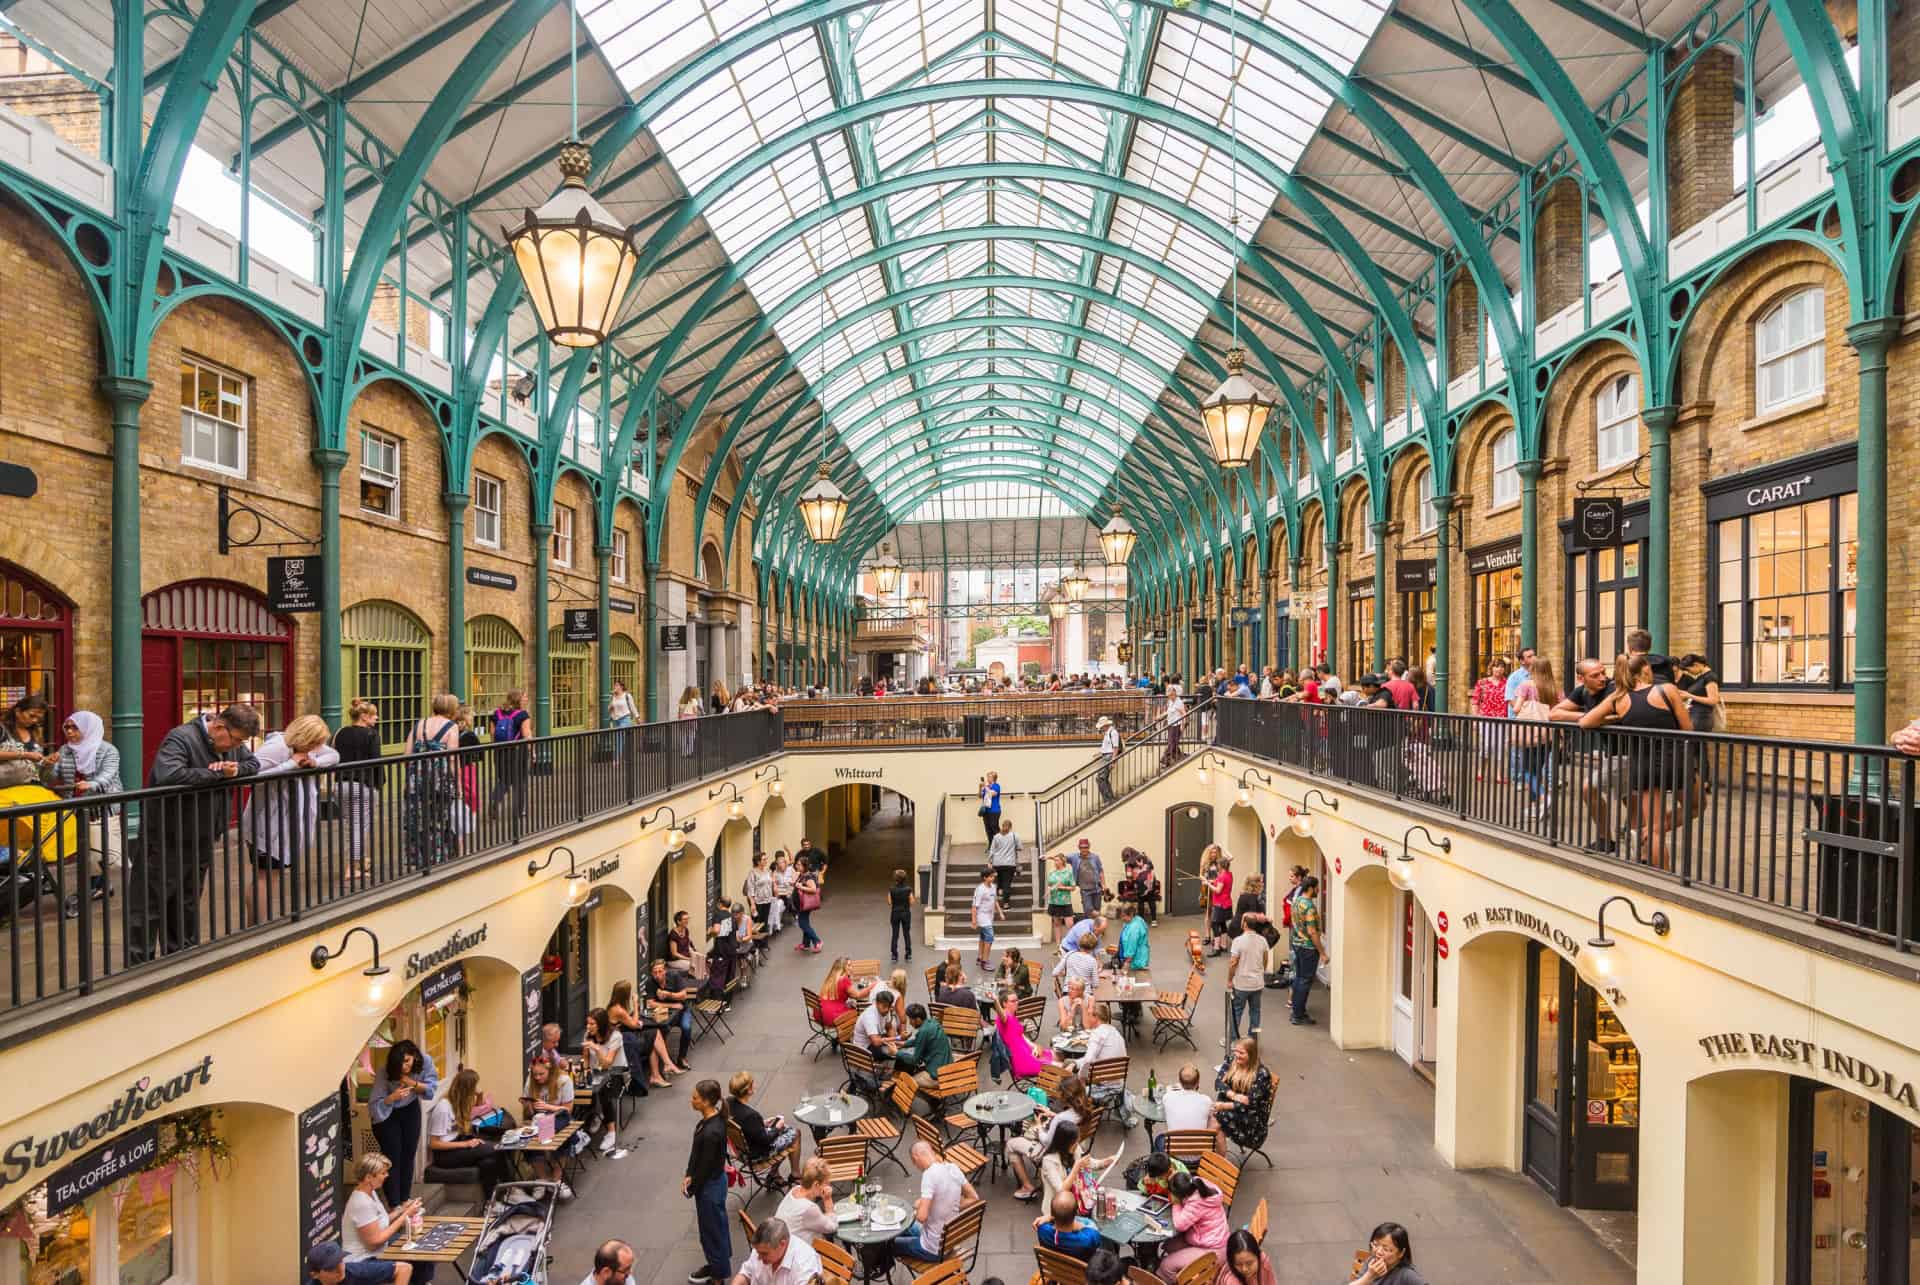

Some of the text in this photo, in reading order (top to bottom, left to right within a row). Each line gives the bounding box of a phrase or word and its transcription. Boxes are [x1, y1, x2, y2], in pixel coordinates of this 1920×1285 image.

[1747, 479, 1803, 506] CARAT
[1486, 548, 1517, 569] Venchi
[835, 767, 883, 778] Whittard
[1485, 907, 1514, 923] EAST
[1514, 909, 1552, 942] INDIA
[406, 922, 488, 979] Sweetheart
[1699, 1032, 1920, 1112] THE EAST INDIA
[0, 1056, 214, 1189] Sweetheart
[119, 1156, 127, 1167] &
[128, 1138, 155, 1163] LOVE
